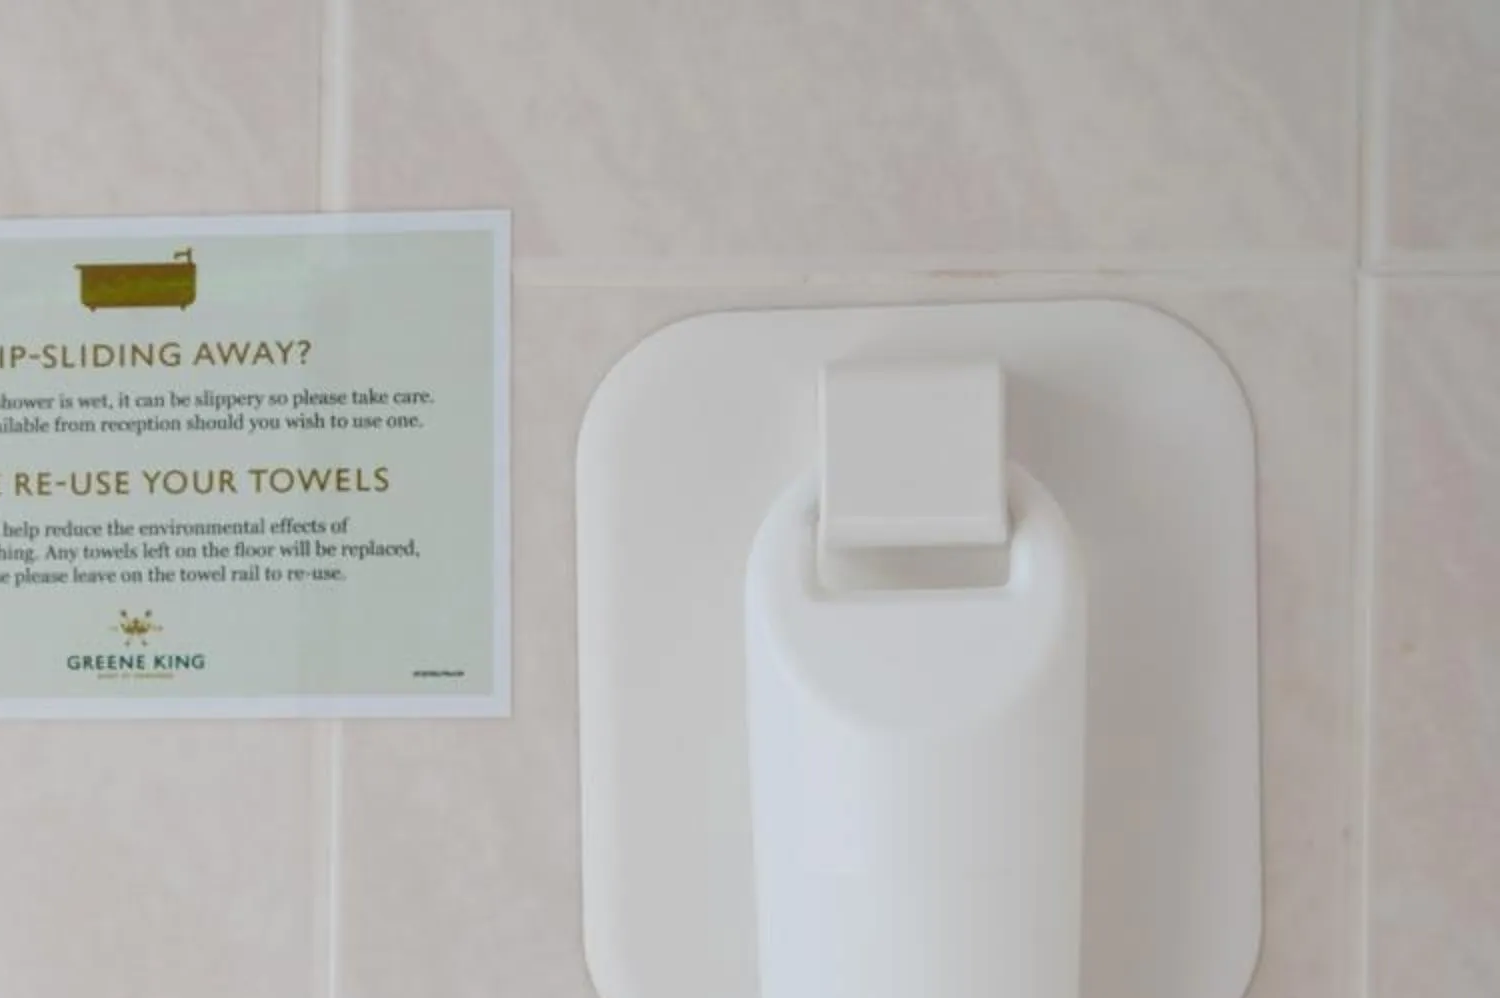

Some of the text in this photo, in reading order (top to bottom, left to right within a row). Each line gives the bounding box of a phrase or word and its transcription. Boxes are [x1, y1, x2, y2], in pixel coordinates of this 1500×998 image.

[193, 340, 311, 366] AWAY?
[60, 394, 73, 409] is
[78, 394, 113, 411] wet,
[118, 392, 130, 409] it
[135, 396, 165, 408] can
[169, 390, 191, 408] be
[195, 389, 264, 409] slippery
[268, 394, 288, 406] so
[293, 387, 347, 408] please
[352, 388, 389, 405] take
[393, 391, 434, 405] care.
[54, 416, 96, 432] from
[101, 416, 181, 434] reception
[186, 413, 244, 432] should
[249, 416, 280, 435] you
[285, 412, 325, 429] wish
[330, 414, 349, 430] to
[352, 416, 383, 429] use
[386, 415, 422, 428] one.
[15, 471, 129, 497] RE-USE
[142, 469, 237, 496] YOUR
[248, 466, 389, 494] TOWELS
[3, 521, 40, 540] help
[45, 520, 103, 538] reduce
[107, 519, 134, 536] the
[138, 517, 265, 537] environmental
[270, 517, 326, 535] effects
[330, 517, 349, 534] of
[45, 545, 78, 563] Any
[83, 542, 138, 561] towels
[143, 542, 170, 559] left
[175, 546, 196, 558] on
[202, 541, 230, 558] the
[234, 541, 276, 558] floor
[280, 540, 311, 558] will
[315, 540, 337, 557] be
[341, 539, 420, 560] replaced,
[14, 566, 68, 587] please
[73, 567, 116, 583] leave
[120, 570, 143, 584] on
[148, 565, 175, 583] the
[180, 565, 226, 582] towel
[231, 564, 260, 582] rail
[265, 567, 283, 582] to
[287, 568, 345, 581] re-use.
[67, 654, 205, 670] GREENE KING
